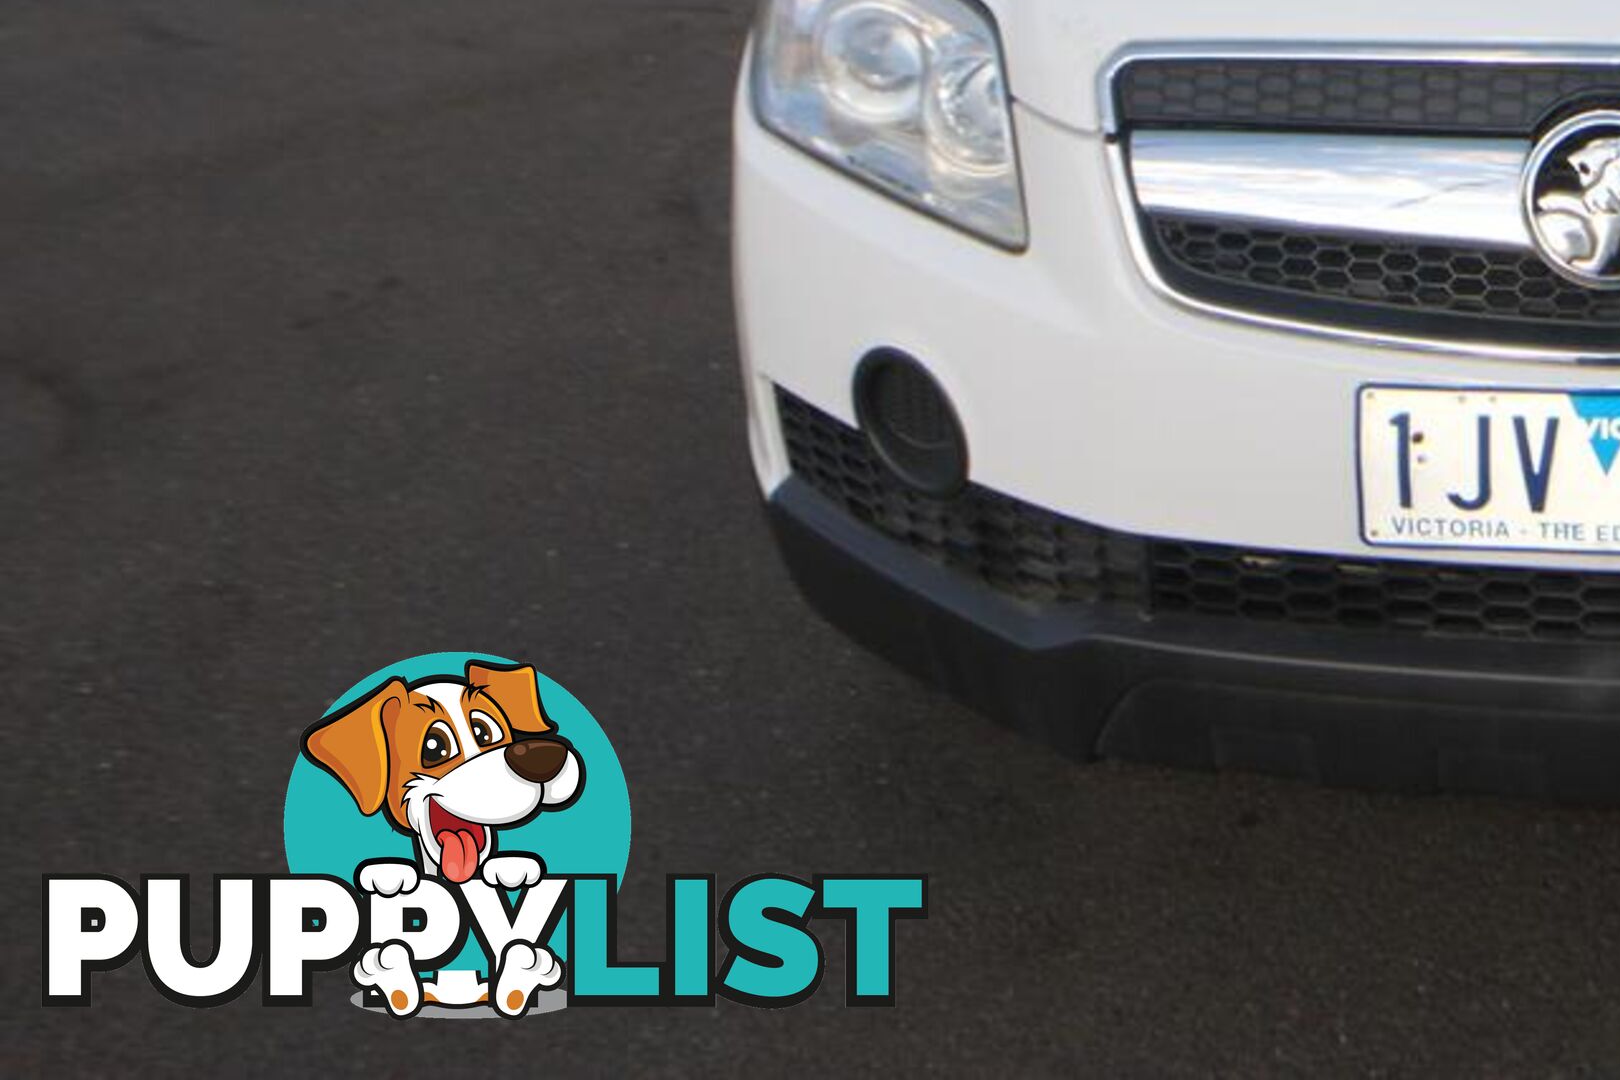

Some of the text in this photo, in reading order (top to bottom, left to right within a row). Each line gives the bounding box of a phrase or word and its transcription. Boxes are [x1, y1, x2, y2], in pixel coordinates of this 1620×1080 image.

[1389, 412, 1560, 513] 1JV
[1391, 517, 1510, 538] VICTORIA
[1539, 523, 1585, 542] THE
